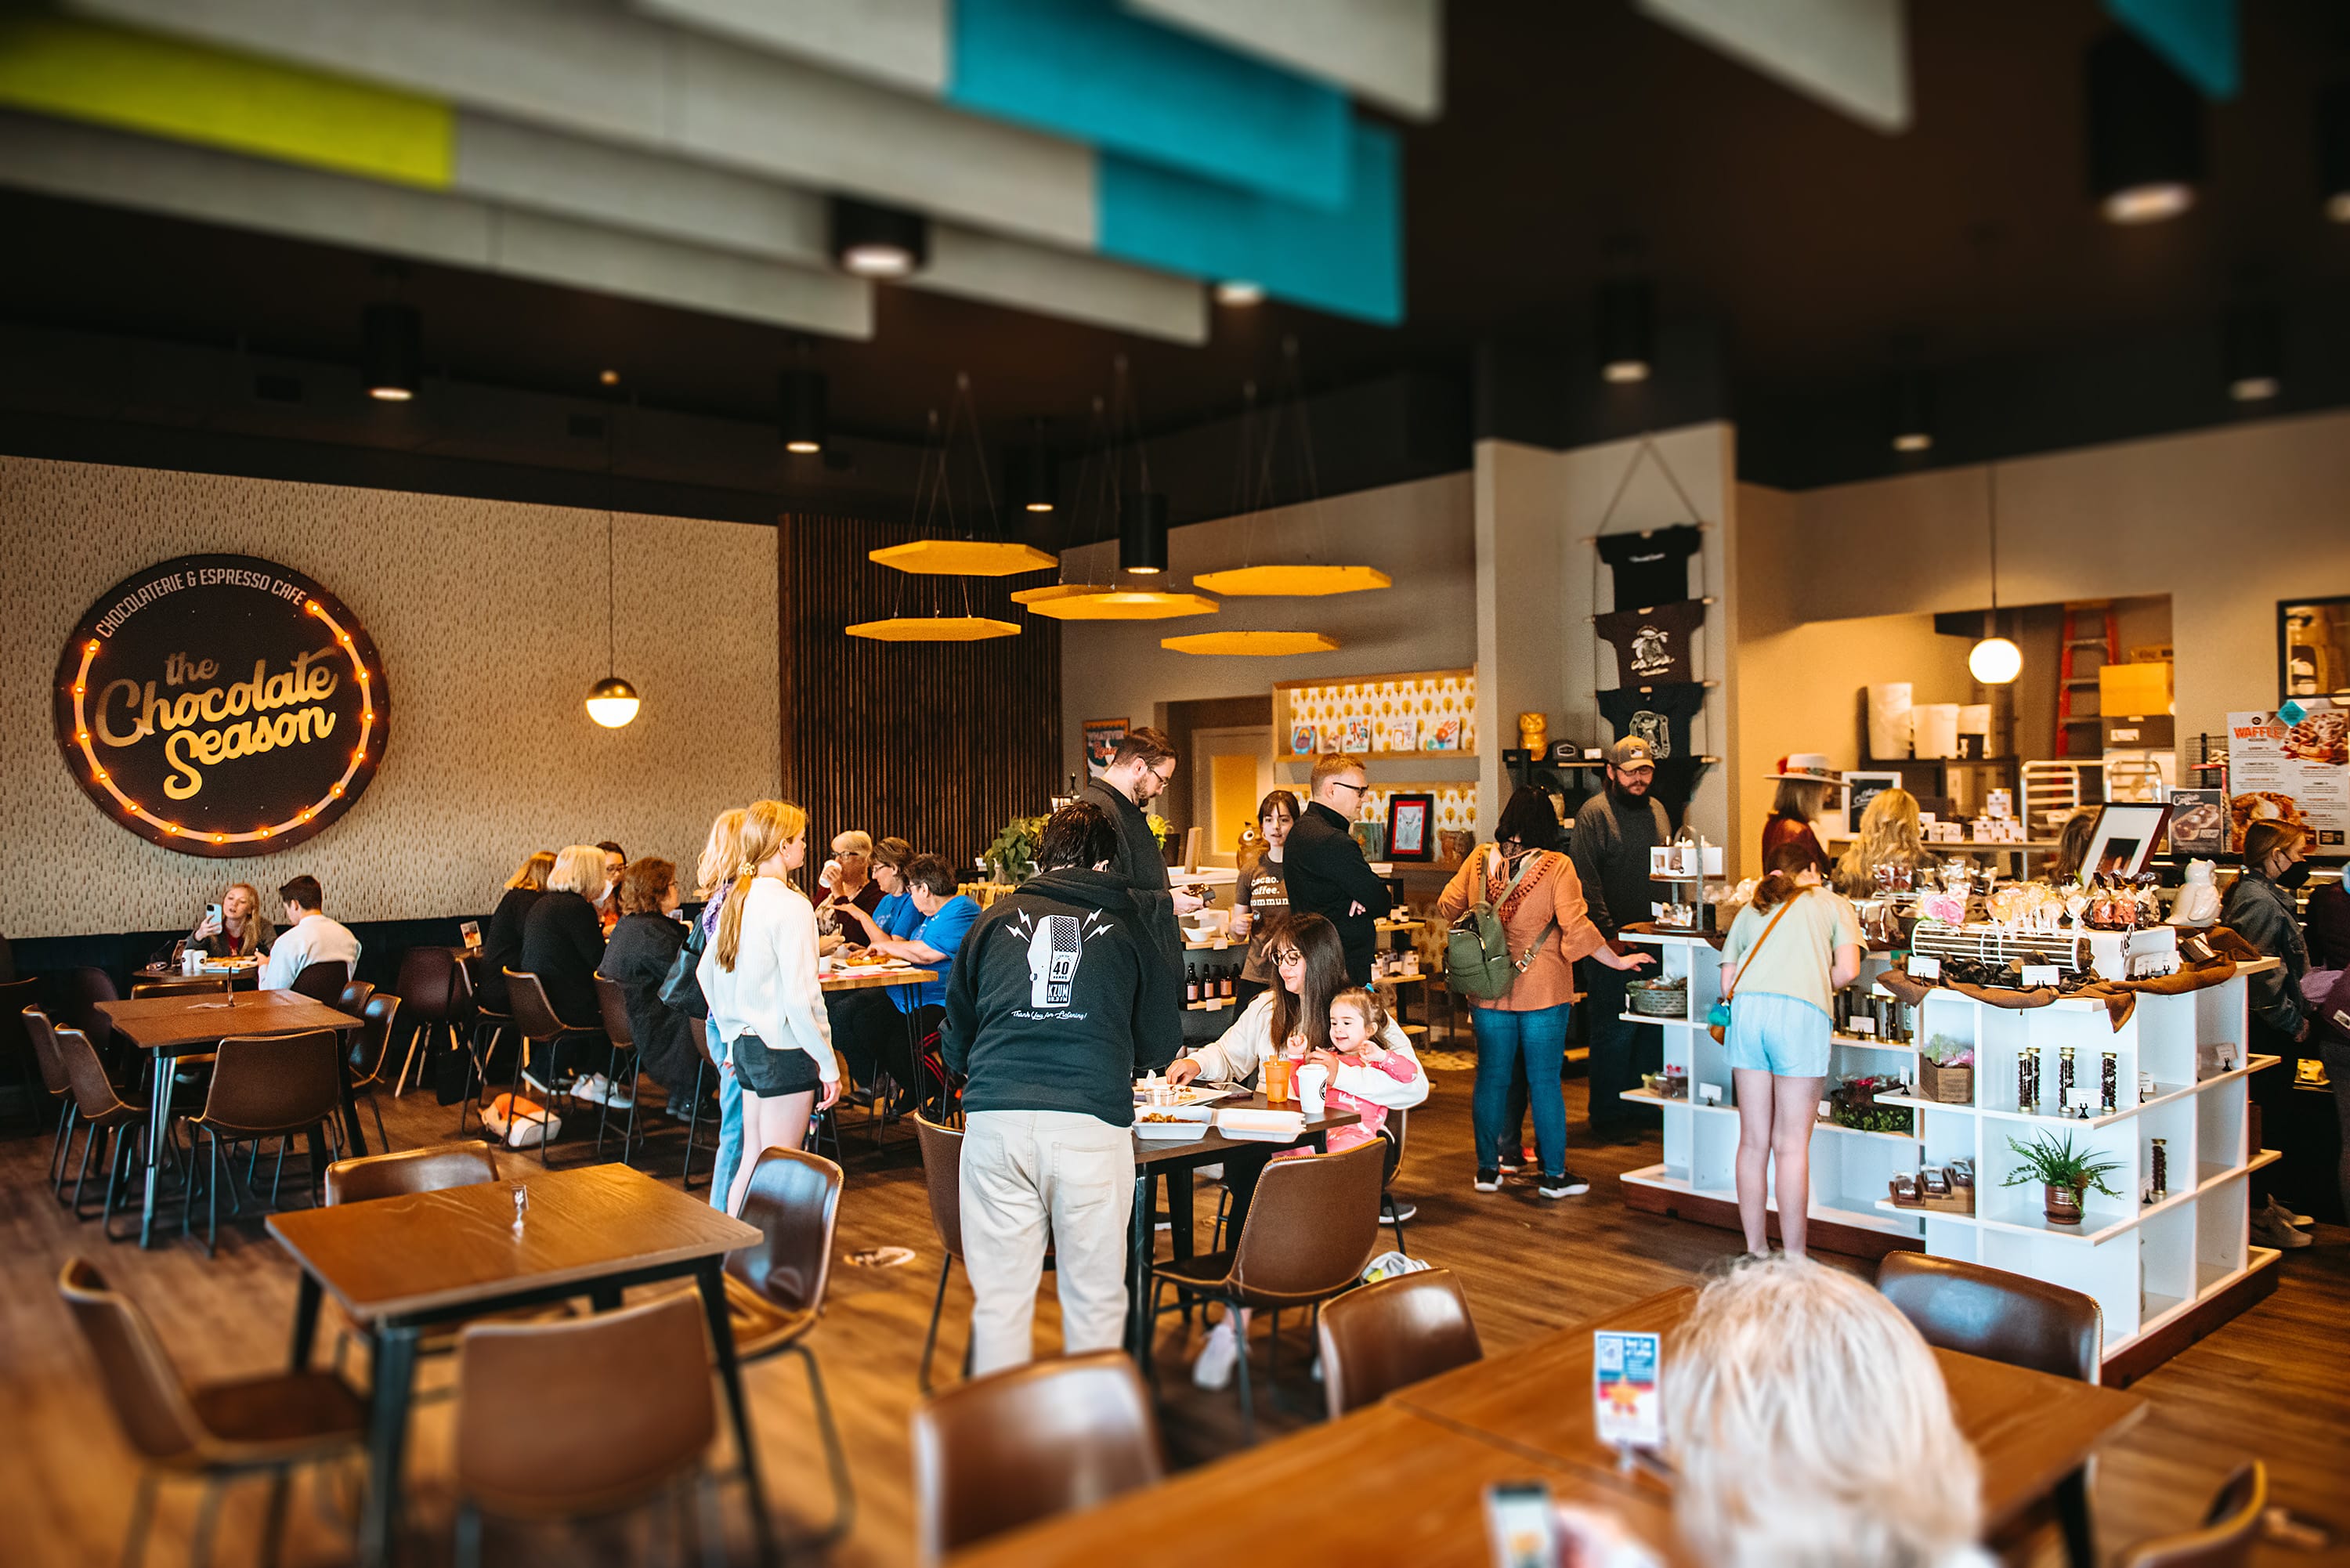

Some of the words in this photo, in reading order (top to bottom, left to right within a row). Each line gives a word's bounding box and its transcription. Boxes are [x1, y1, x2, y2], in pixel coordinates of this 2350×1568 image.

[96, 573, 185, 638] CHOCOLATERIE
[186, 571, 196, 587] &
[199, 569, 270, 591] ESPRESSO
[271, 580, 307, 606] CAFE
[165, 652, 219, 686] the
[95, 645, 342, 747] Chocolate
[2233, 726, 2283, 740] WAFFLE
[163, 706, 337, 800] Season
[1251, 876, 1279, 887] cacao.
[1053, 961, 1069, 974] 40
[1047, 984, 1069, 997] KZUM
[1010, 1010, 1030, 1018] Thank
[1031, 1011, 1043, 1020] You
[1043, 1011, 1054, 1020] for
[1054, 1010, 1088, 1021] Listening!
